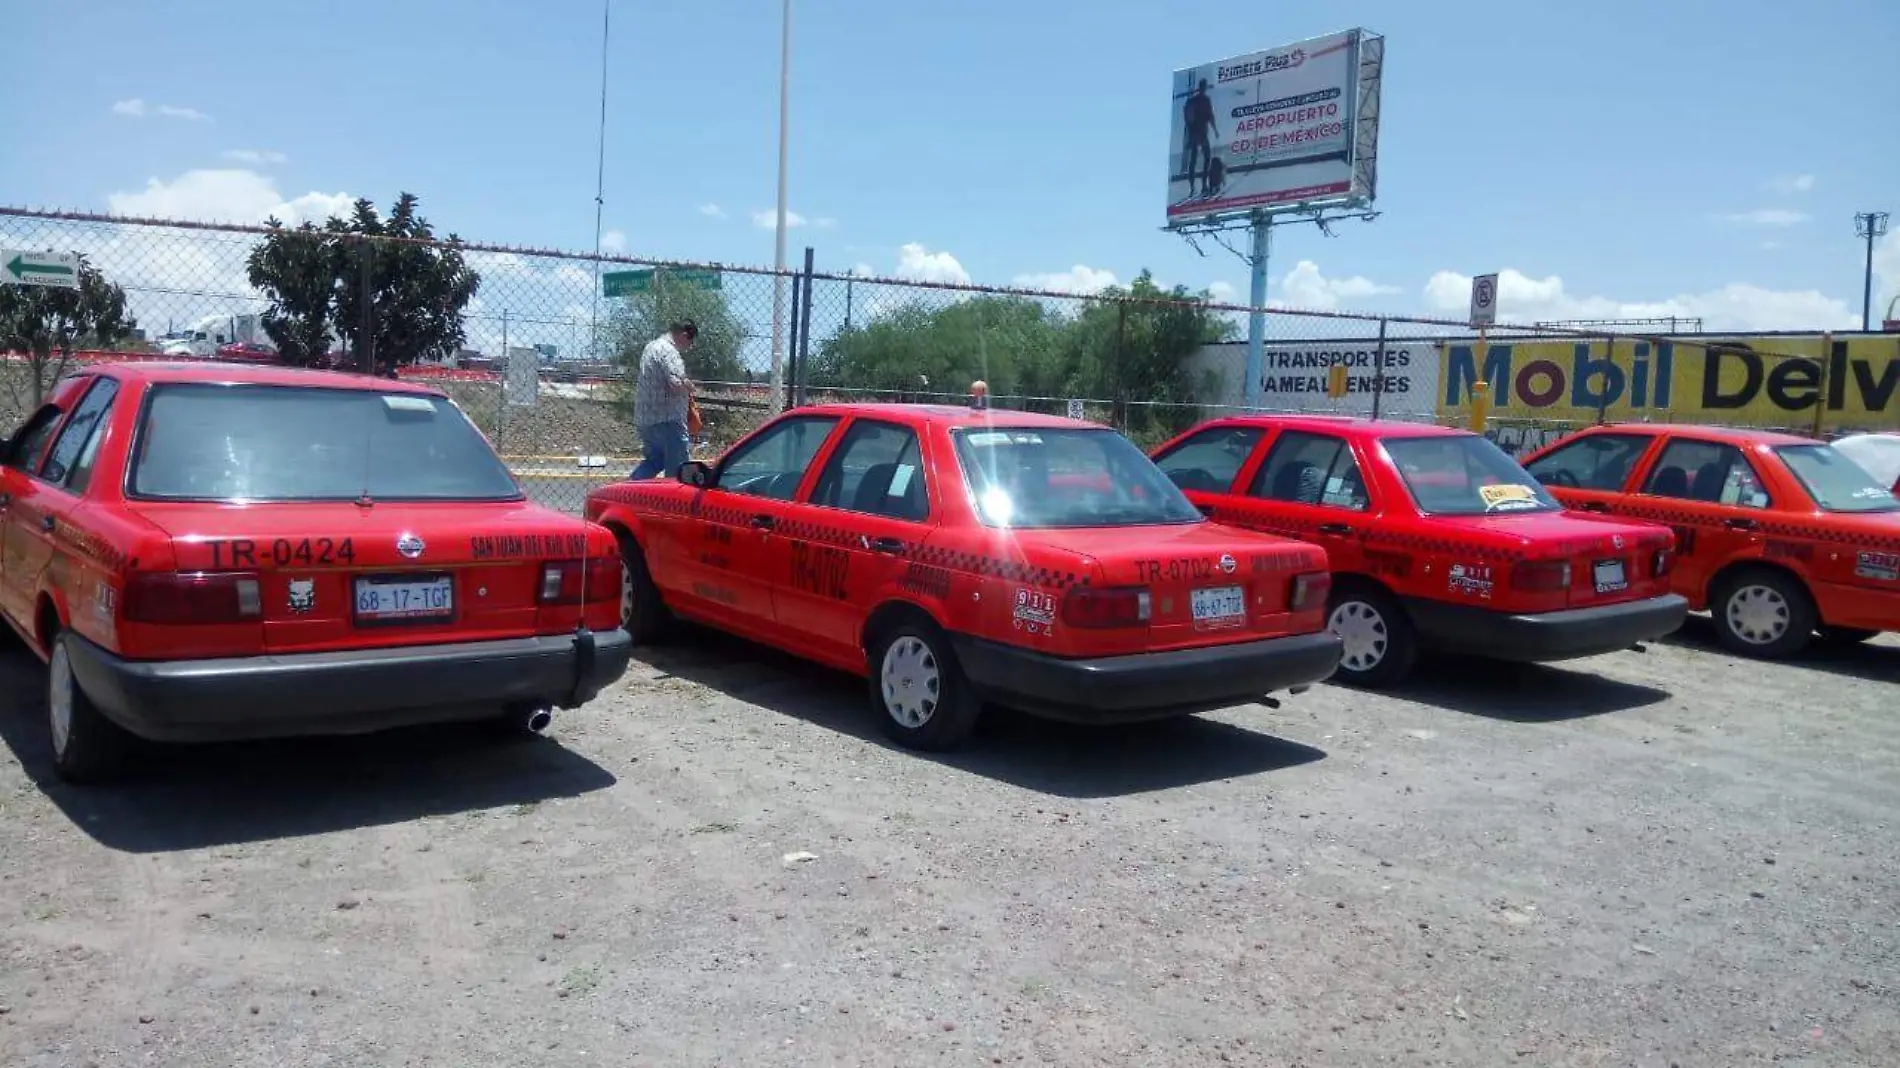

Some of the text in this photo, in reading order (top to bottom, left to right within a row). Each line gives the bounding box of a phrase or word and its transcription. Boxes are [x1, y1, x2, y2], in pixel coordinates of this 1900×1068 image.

[1218, 60, 1261, 80] Primera
[1236, 103, 1338, 135] AEROPUERTO
[1258, 134, 1278, 149] DE
[1267, 350, 1411, 369] TRANSPORTES
[1445, 342, 1672, 410] Mobil
[203, 537, 356, 569] TR-0424
[1136, 556, 1213, 584] TR-0702
